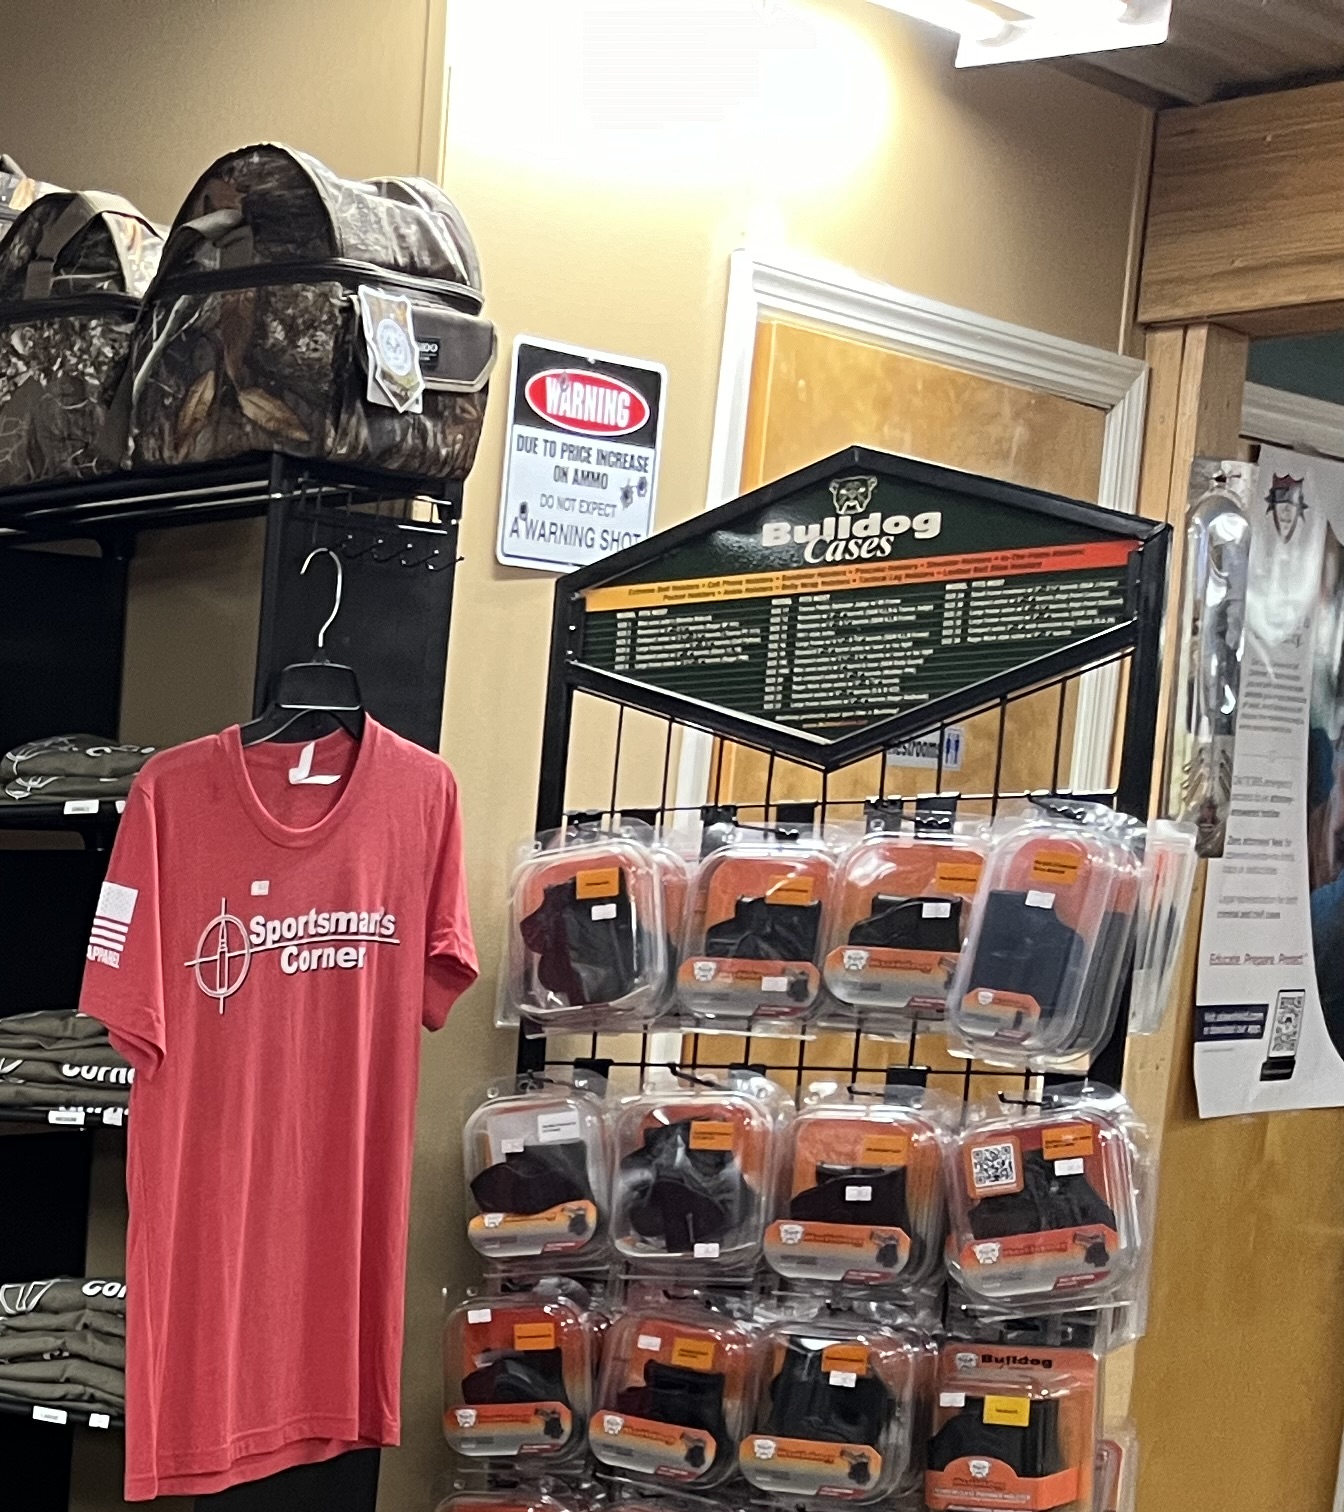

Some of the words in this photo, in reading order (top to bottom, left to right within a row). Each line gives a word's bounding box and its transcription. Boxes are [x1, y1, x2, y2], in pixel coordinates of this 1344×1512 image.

[545, 376, 631, 428] WARNING
[516, 433, 538, 455] DUE
[543, 439, 556, 458] TO
[560, 442, 592, 465] PRICE
[596, 448, 649, 473] INCREASE
[553, 465, 568, 484] ON
[572, 468, 609, 490] AMMO
[540, 493, 553, 509] DO
[556, 495, 576, 512] NOT
[578, 499, 617, 518] EXPECT
[509, 517, 520, 538] A
[524, 518, 595, 550] WARNING
[761, 511, 942, 548] Bulldog
[803, 533, 894, 565] Cases
[249, 906, 396, 945] Sportsman's
[281, 943, 367, 975] Corner
[981, 1353, 1053, 1369] Bulldog
